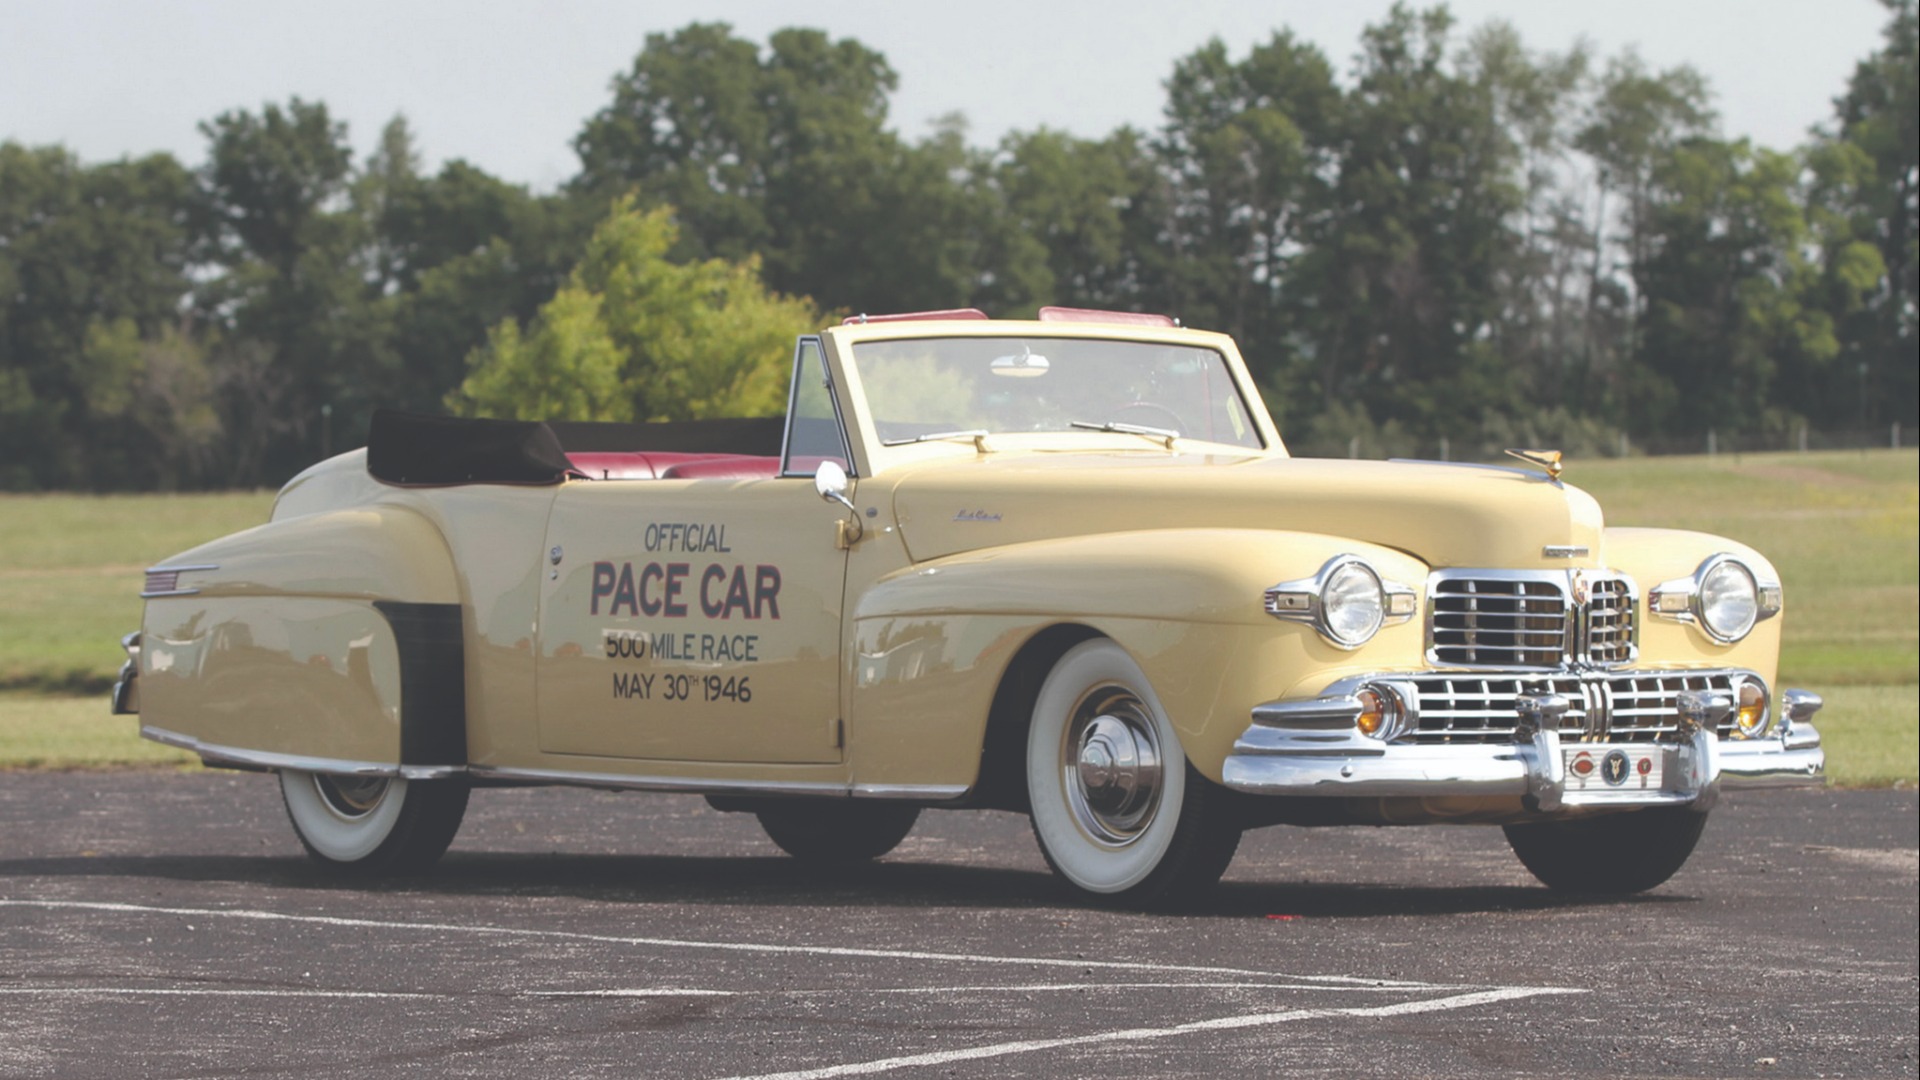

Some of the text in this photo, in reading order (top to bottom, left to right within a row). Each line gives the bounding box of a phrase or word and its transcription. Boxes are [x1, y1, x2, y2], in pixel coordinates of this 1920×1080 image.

[645, 523, 731, 552] OFFICIAL
[590, 561, 782, 620] PACE CAR
[606, 632, 758, 662] 500 MILE RACE
[613, 673, 655, 699] MAY
[703, 675, 751, 703] 1946
